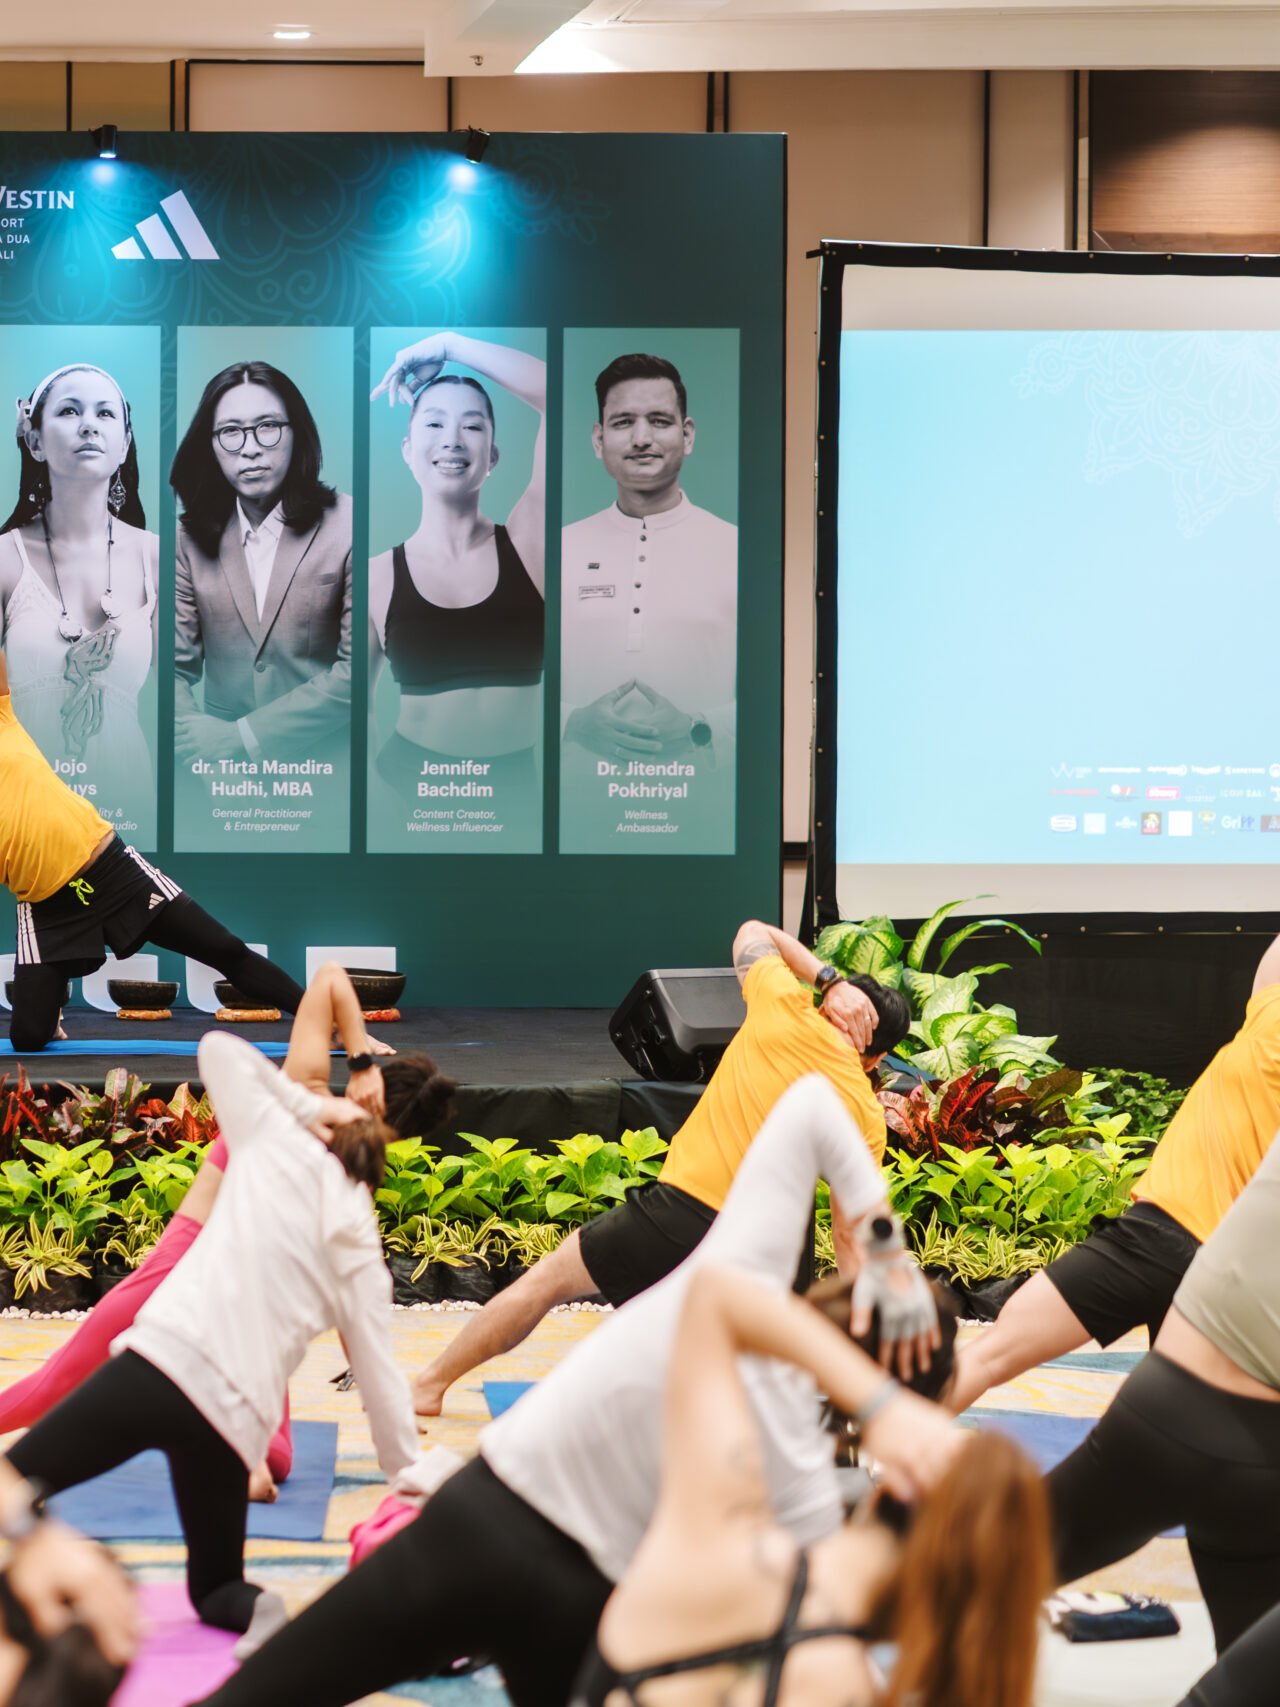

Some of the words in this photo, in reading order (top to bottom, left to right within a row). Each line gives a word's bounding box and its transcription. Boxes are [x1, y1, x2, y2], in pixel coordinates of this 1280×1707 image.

[7, 234, 30, 244] DUA
[53, 759, 87, 776] Jojo
[191, 759, 214, 775] dr.
[218, 759, 258, 775] Tirta
[262, 759, 333, 775] Mandira
[420, 759, 491, 775] Jennifer
[597, 761, 621, 776] Dr.
[625, 760, 695, 776] Jitendra
[68, 783, 97, 797] uys
[211, 781, 268, 798] Hudhi,
[273, 782, 313, 796] MBA
[417, 781, 493, 797] Bachdim
[608, 782, 688, 801] Pokhriyal
[115, 808, 123, 818] &
[212, 808, 252, 818] General
[254, 808, 313, 818] Practitioner
[413, 809, 454, 819] Content
[456, 809, 497, 820] Creator,
[624, 810, 668, 820] Wellness
[224, 822, 232, 831] &
[234, 822, 301, 832] Entrepreneur
[406, 822, 450, 832] Wellness
[452, 822, 504, 832] Influencer
[616, 822, 679, 833] Ambassador
